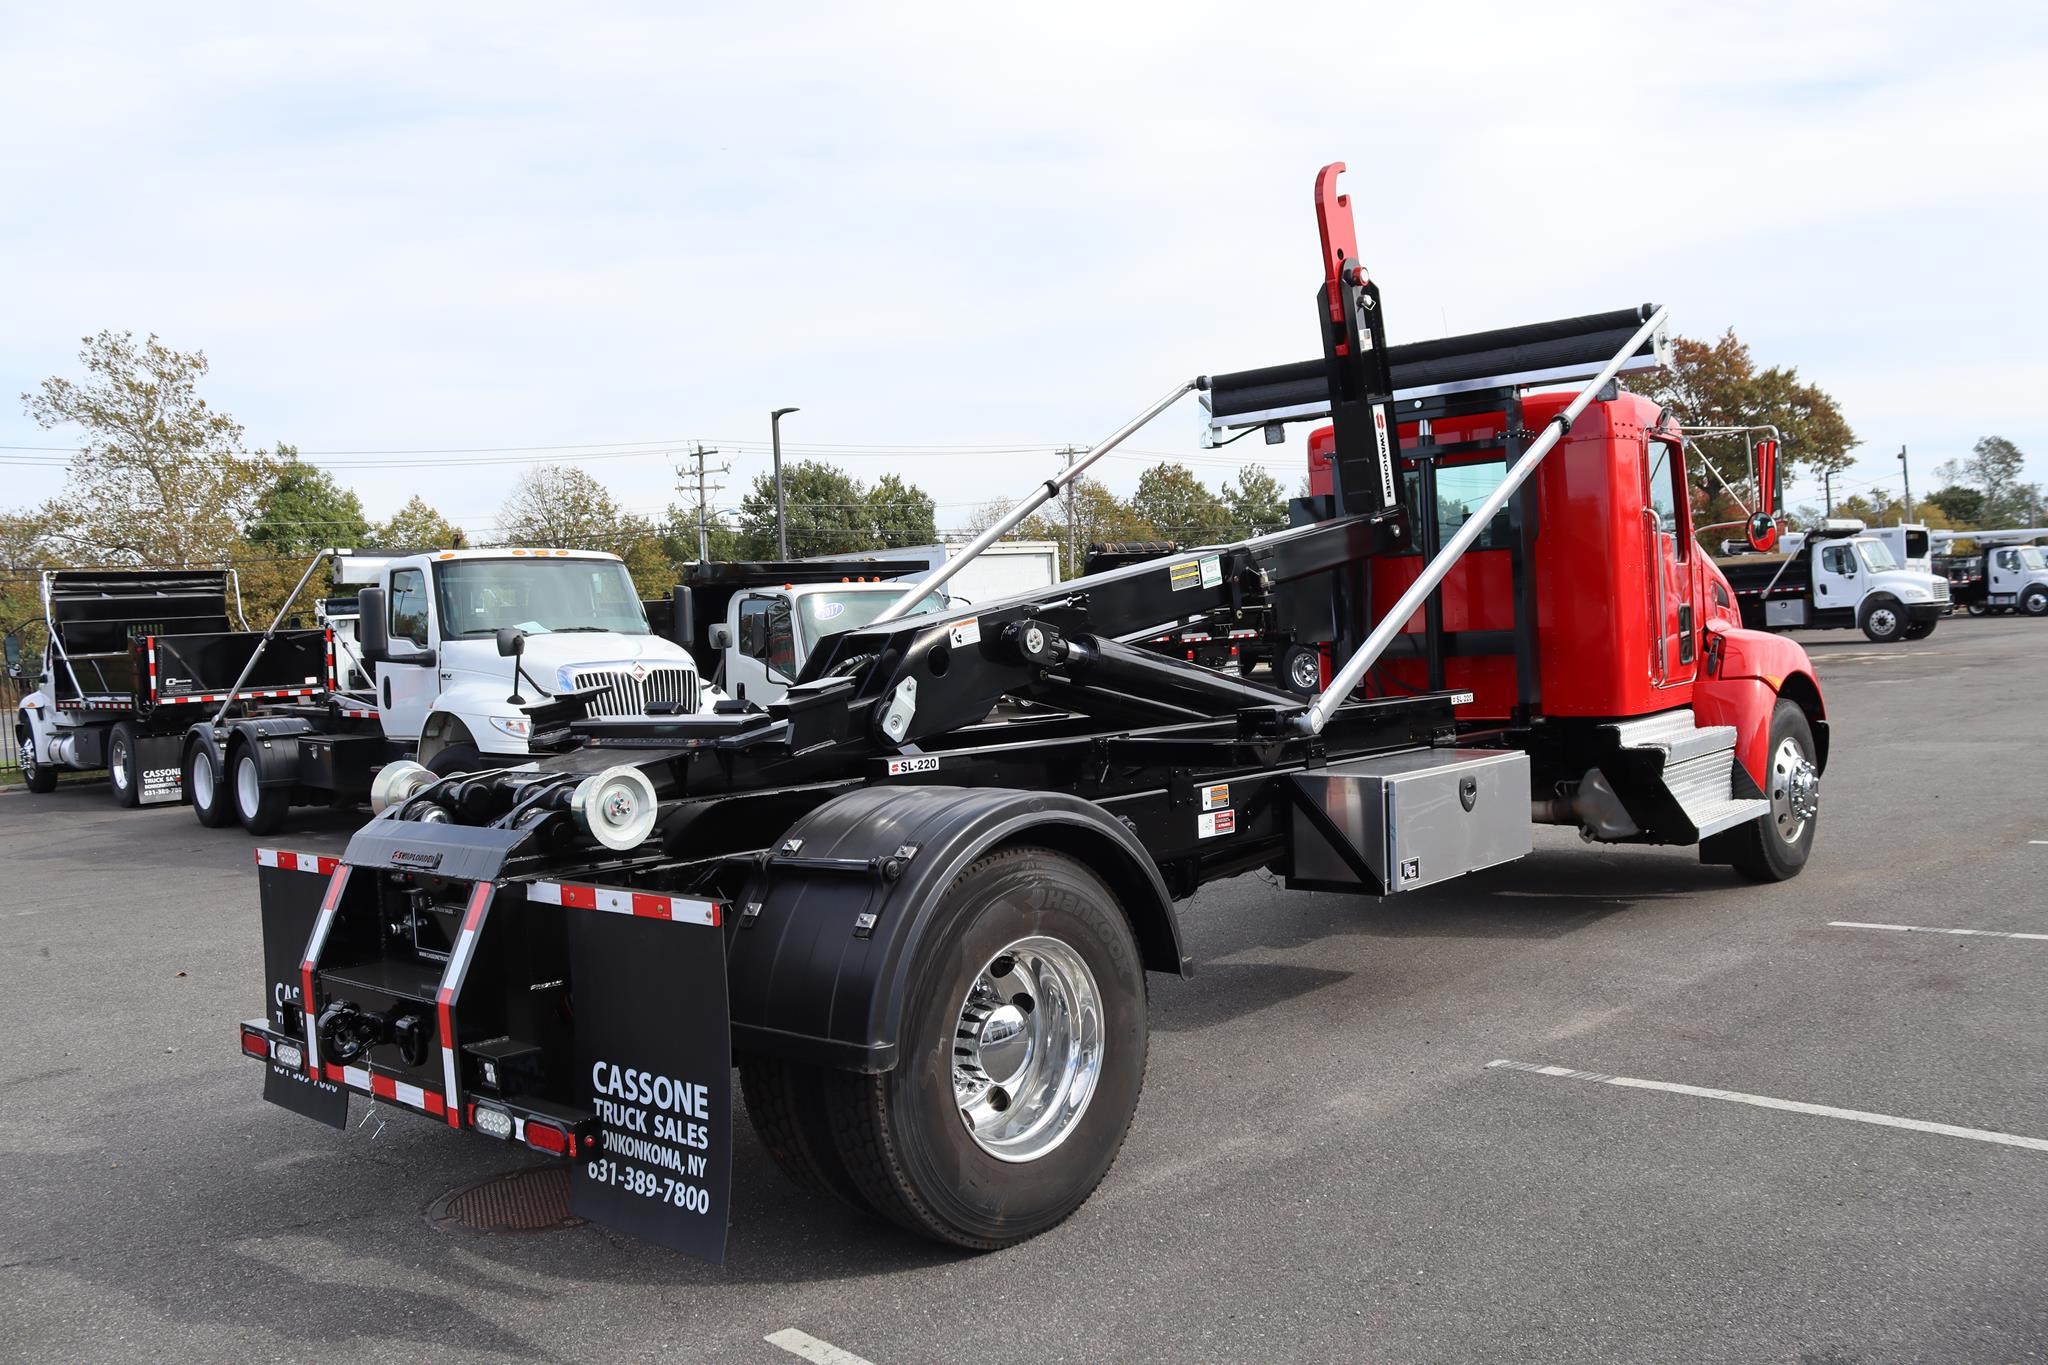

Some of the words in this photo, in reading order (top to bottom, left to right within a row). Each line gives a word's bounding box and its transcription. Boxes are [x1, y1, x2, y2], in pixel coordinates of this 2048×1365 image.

[1378, 431, 1392, 498] SWAPLOADER
[900, 758, 937, 772] SL-220
[592, 1060, 709, 1120] CASSONE
[593, 1097, 647, 1134] TRUCK
[654, 1113, 709, 1150] SALES
[602, 1130, 686, 1176] ONKONKOMA,
[688, 1153, 707, 1179] NY
[588, 1158, 710, 1215] 631-389-7800
